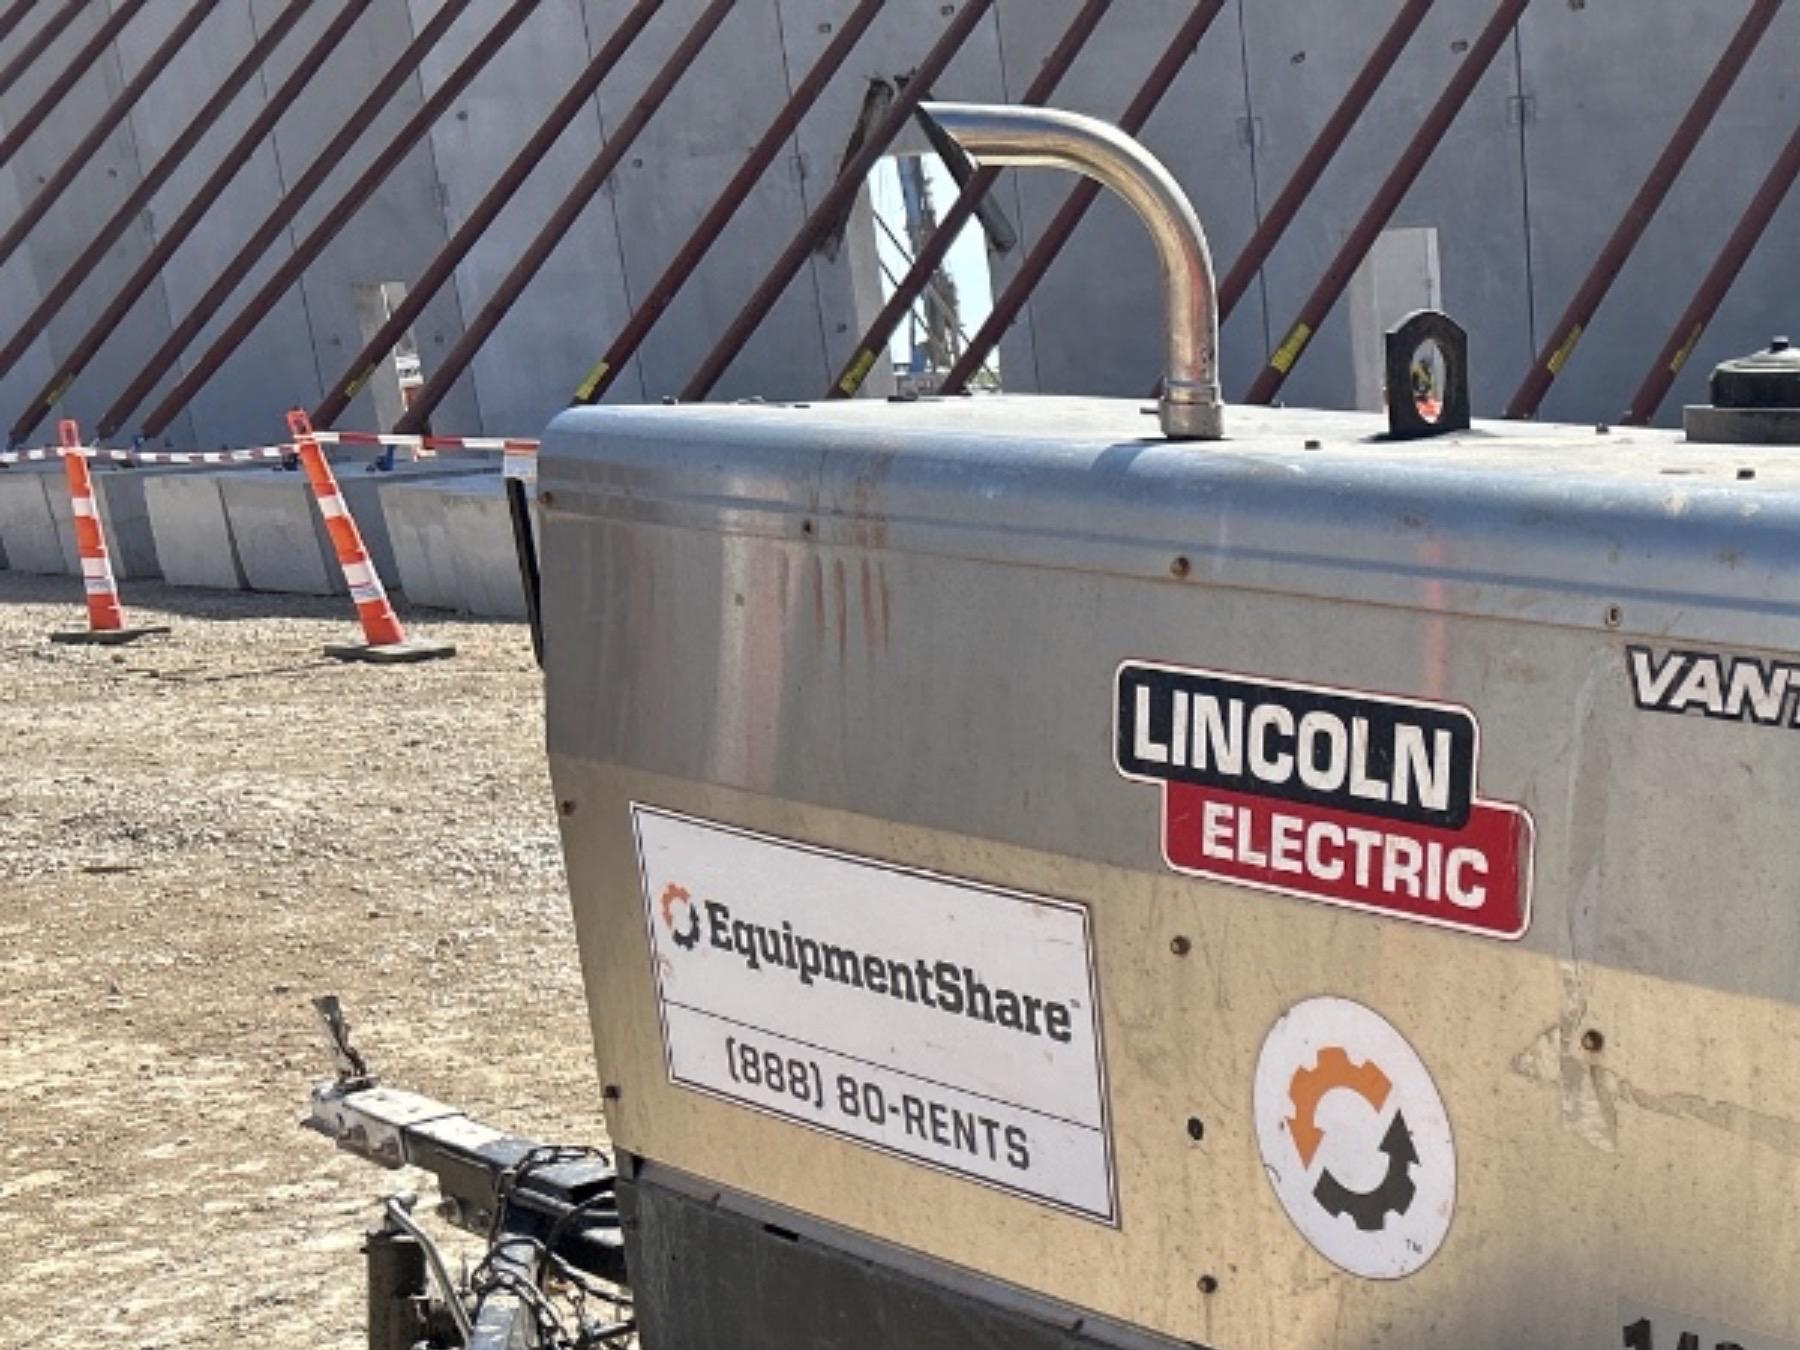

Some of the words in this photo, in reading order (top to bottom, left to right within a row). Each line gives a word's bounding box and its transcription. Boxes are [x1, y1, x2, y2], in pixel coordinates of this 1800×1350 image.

[1133, 685, 1453, 812] LINCOLN
[1201, 800, 1490, 910] ELECTRIC
[703, 900, 1074, 1043] EquipmentShare
[726, 1036, 824, 1109] (888)
[836, 1075, 1031, 1171] 80-RENTS
